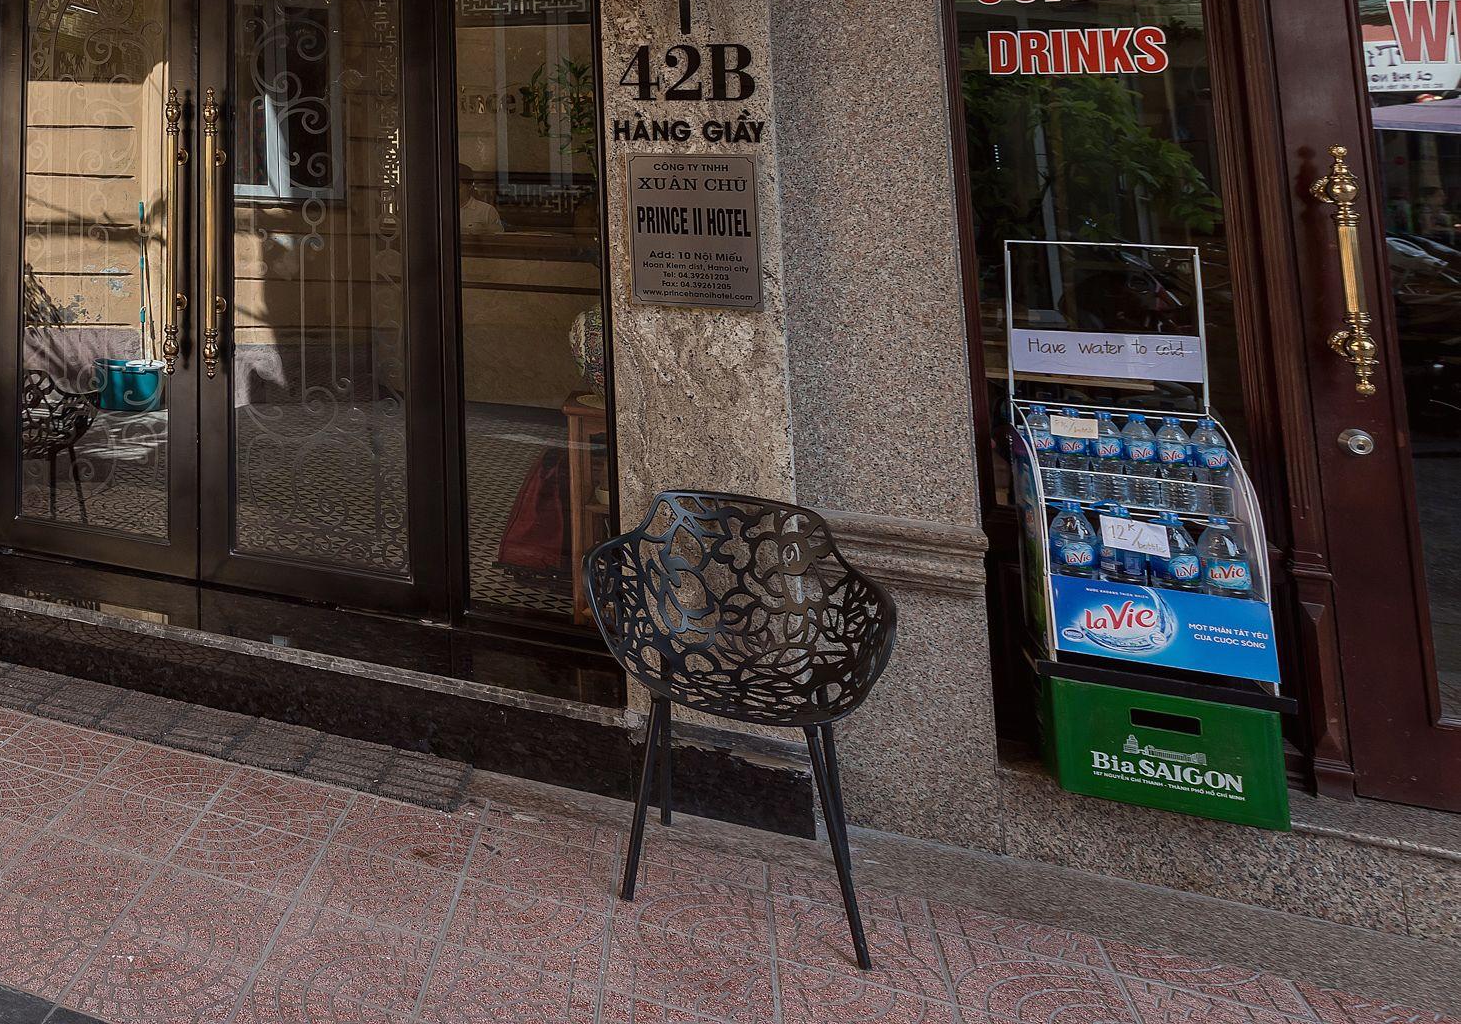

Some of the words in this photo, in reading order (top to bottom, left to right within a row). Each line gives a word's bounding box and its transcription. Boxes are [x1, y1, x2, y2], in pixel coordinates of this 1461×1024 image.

[987, 26, 1169, 75] DRINKS
[619, 43, 756, 101] 42B
[613, 112, 692, 142] HÀNG
[702, 109, 765, 143] GIẦY
[653, 162, 685, 171] CÔNG
[688, 163, 699, 171] TY
[701, 164, 729, 172] TNHH
[637, 175, 698, 191] XUÂN
[636, 205, 689, 235] PRINCE
[692, 207, 703, 236] II
[706, 208, 752, 237] HOTEL
[649, 250, 675, 259] Add:
[678, 252, 690, 260] 10
[694, 252, 712, 262] Nội
[707, 264, 732, 272] Hanoi
[734, 265, 749, 273] city
[642, 289, 753, 301] www.princehanoihotel.com
[1028, 338, 1067, 354] Have
[1078, 341, 1125, 355] water
[1133, 339, 1147, 355] to
[1084, 601, 1156, 629] laVie
[1090, 750, 1137, 775] Bia
[1138, 759, 1243, 793] SAIGON
